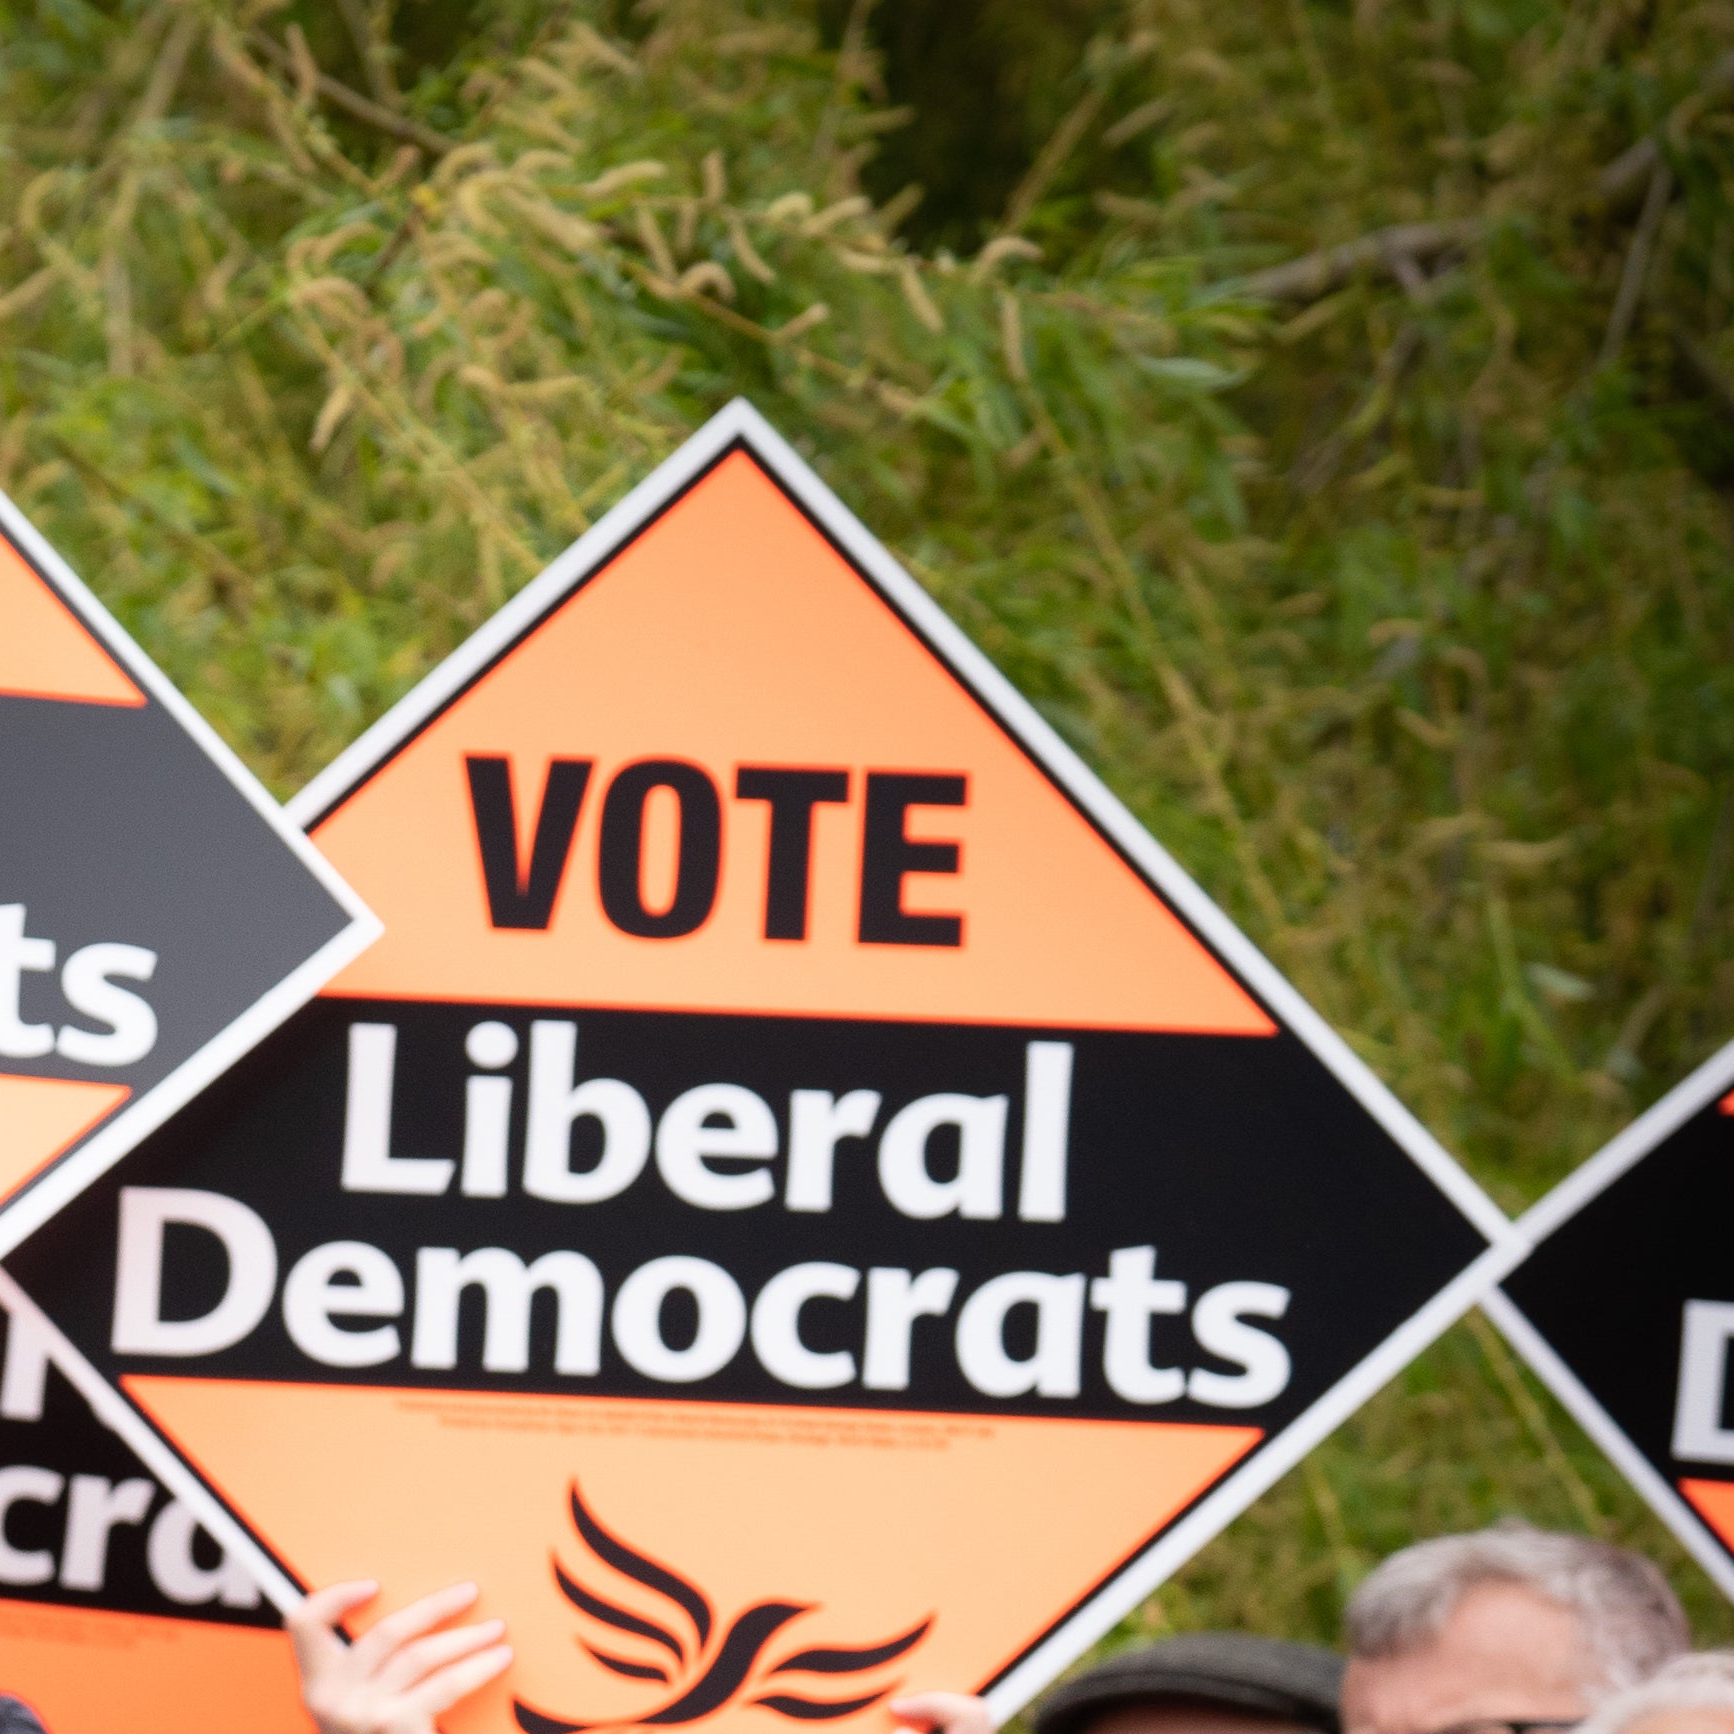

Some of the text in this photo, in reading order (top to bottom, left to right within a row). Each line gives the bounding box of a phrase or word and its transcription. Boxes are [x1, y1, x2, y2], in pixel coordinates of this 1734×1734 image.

[463, 753, 970, 952] VOTE
[339, 1018, 1074, 1225] Liberal
[112, 1184, 1292, 1411] Democrats
